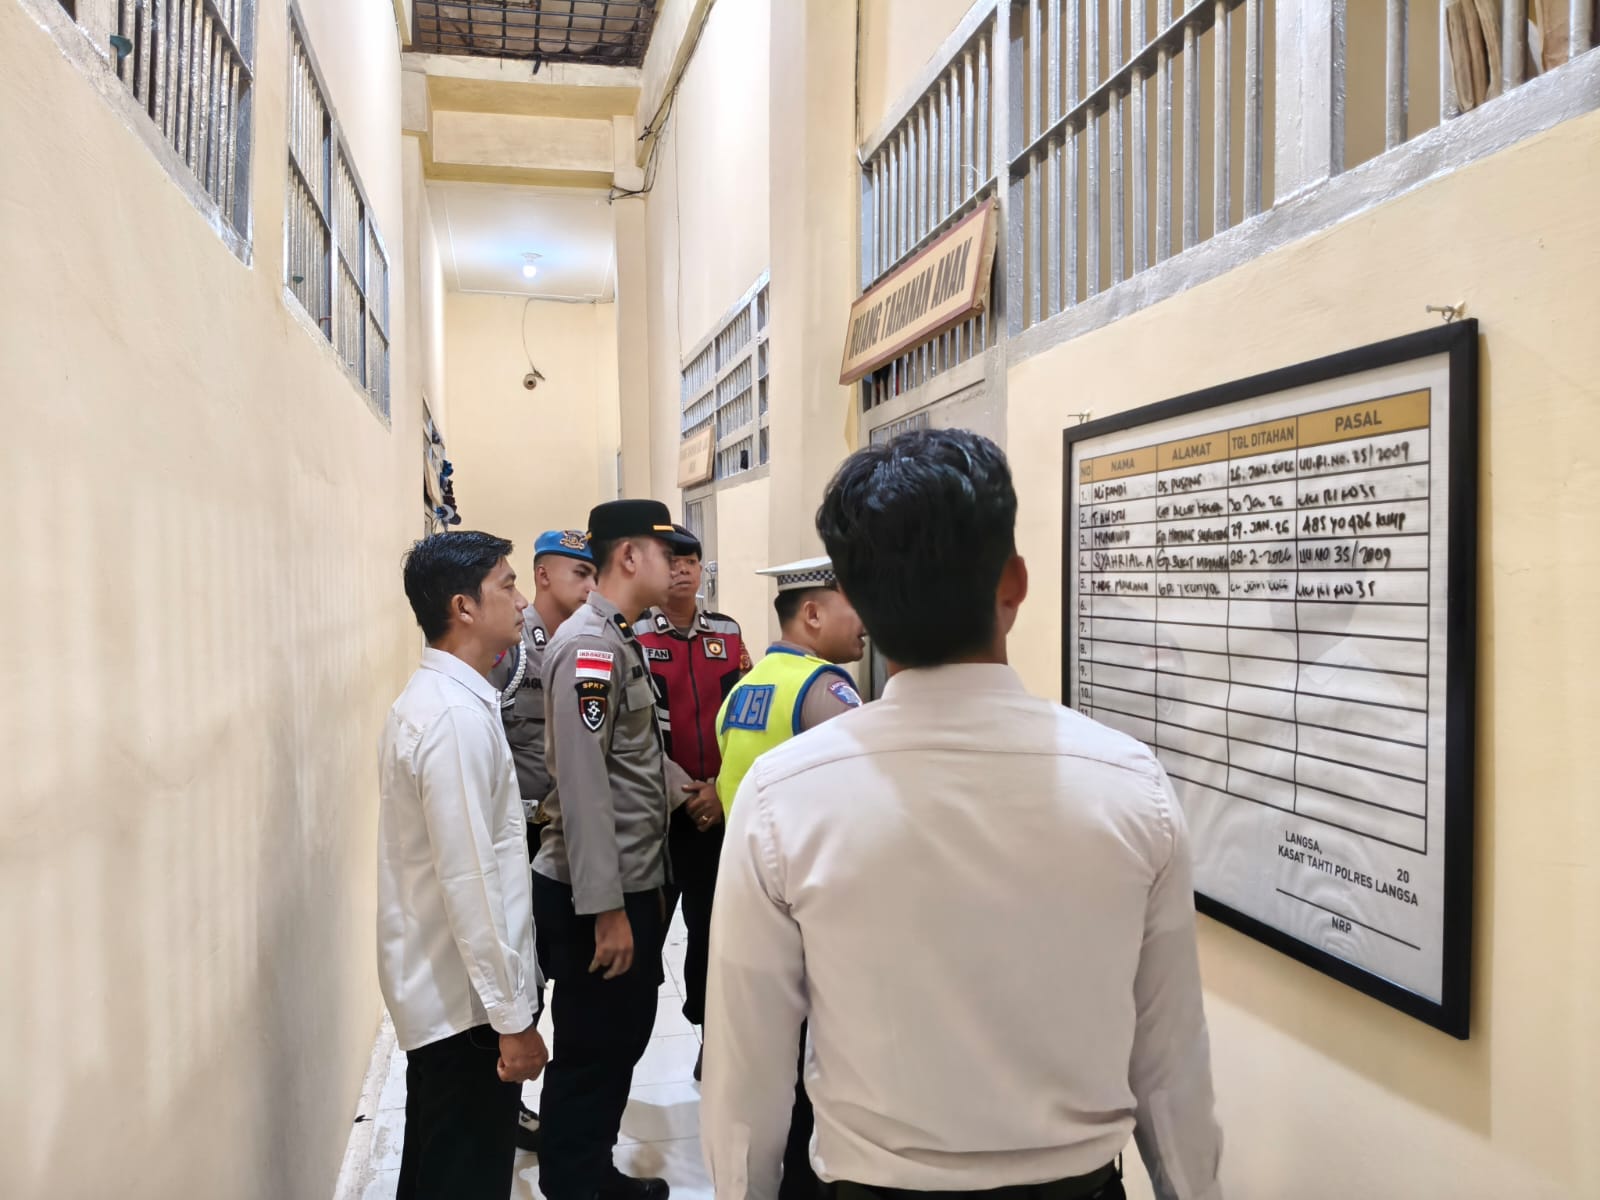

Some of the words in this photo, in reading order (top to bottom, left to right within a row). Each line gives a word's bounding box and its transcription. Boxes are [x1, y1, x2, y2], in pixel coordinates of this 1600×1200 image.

[849, 301, 882, 361] RUANG
[881, 264, 935, 341] TAHANAN
[931, 236, 973, 310] ANAK
[1111, 459, 1135, 472] NAMA
[1172, 442, 1212, 460] ALAMAT
[1232, 436, 1249, 450] TGL
[1252, 426, 1294, 447] DITAHAN
[1335, 410, 1382, 432] PASAL
[1080, 600, 1087, 611] 6.
[1080, 622, 1087, 633] 7.
[1080, 643, 1087, 655] 8.
[579, 651, 612, 660] INDONESIA
[1080, 665, 1087, 677] 9.
[1080, 687, 1091, 699] 10.
[1285, 830, 1322, 854] LANGSA,
[1397, 868, 1409, 883] 20
[1278, 844, 1305, 864] KASAT
[1307, 854, 1333, 874] TAHTI
[1334, 865, 1373, 889] POLRES
[1375, 880, 1419, 906] LANGSA
[1331, 916, 1352, 934] NRP
